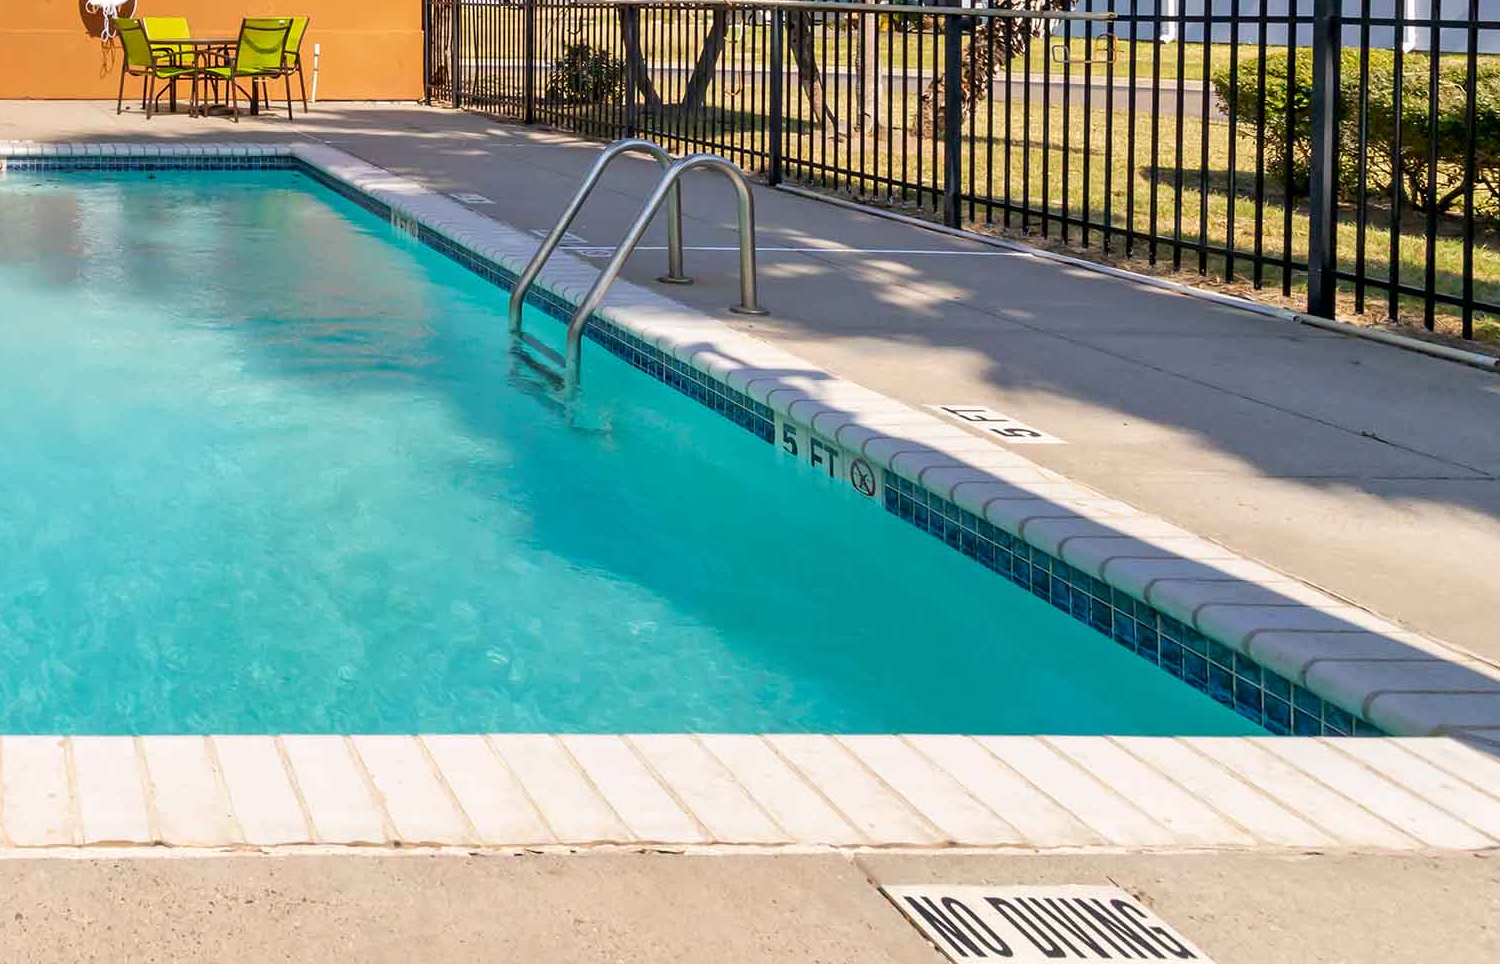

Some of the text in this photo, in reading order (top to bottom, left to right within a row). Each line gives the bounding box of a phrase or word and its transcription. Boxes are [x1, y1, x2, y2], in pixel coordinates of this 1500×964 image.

[940, 406, 1042, 438] 5 FT
[783, 423, 839, 478] 5 FT
[904, 896, 1199, 959] NO DIVING
